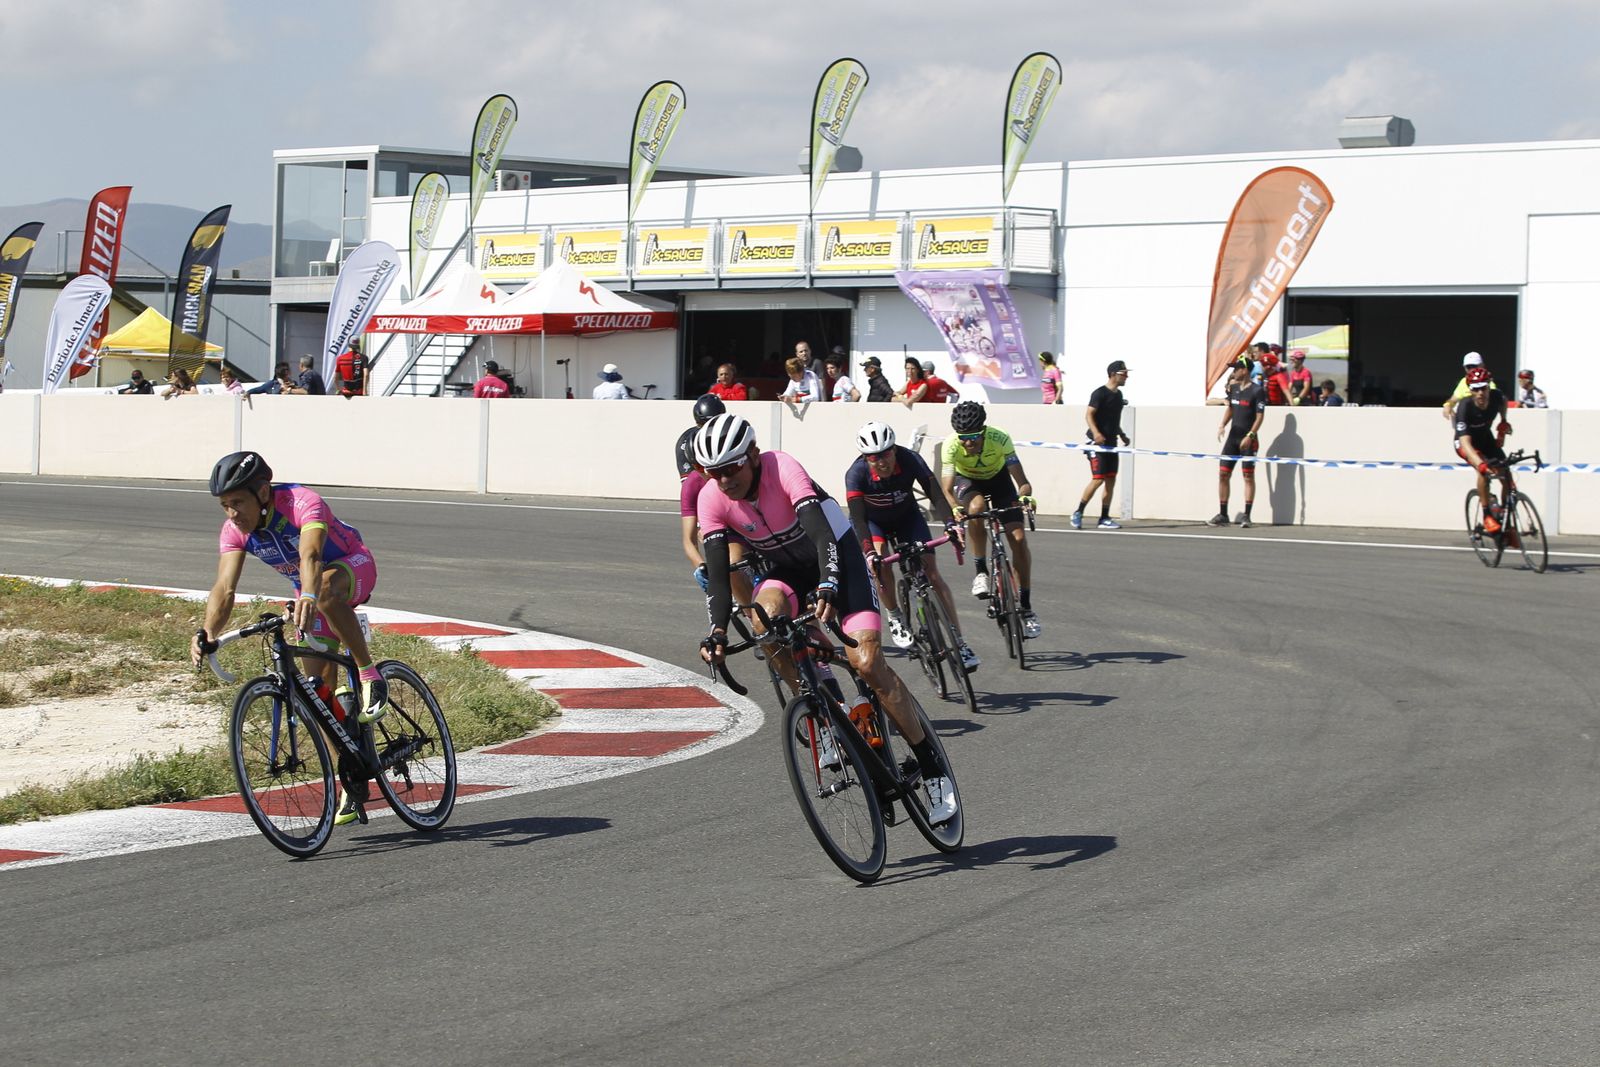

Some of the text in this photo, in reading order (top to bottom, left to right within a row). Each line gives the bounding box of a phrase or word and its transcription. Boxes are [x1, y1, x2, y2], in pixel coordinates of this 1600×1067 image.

[830, 71, 861, 134] X-SAUCE
[1023, 66, 1055, 130] X-SAUCE
[648, 93, 680, 154] X-SAUCE
[485, 106, 512, 161] X-SAUCE
[422, 183, 445, 240] X-SAUCE
[652, 247, 704, 262] X-SAUCE
[740, 244, 795, 260] X-SAUCE
[833, 241, 892, 257] X-SAUCE
[928, 238, 989, 255] X-SAUCE
[489, 252, 536, 266] X-SAUCE
[567, 250, 617, 264] X-SAUCE
[1231, 181, 1322, 334] infisport
[182, 264, 206, 334] TRACKMAN
[376, 317, 427, 331] SPECIALIZED
[465, 317, 523, 331] SPECIALIZED
[573, 314, 652, 329] SPECIALIZED
